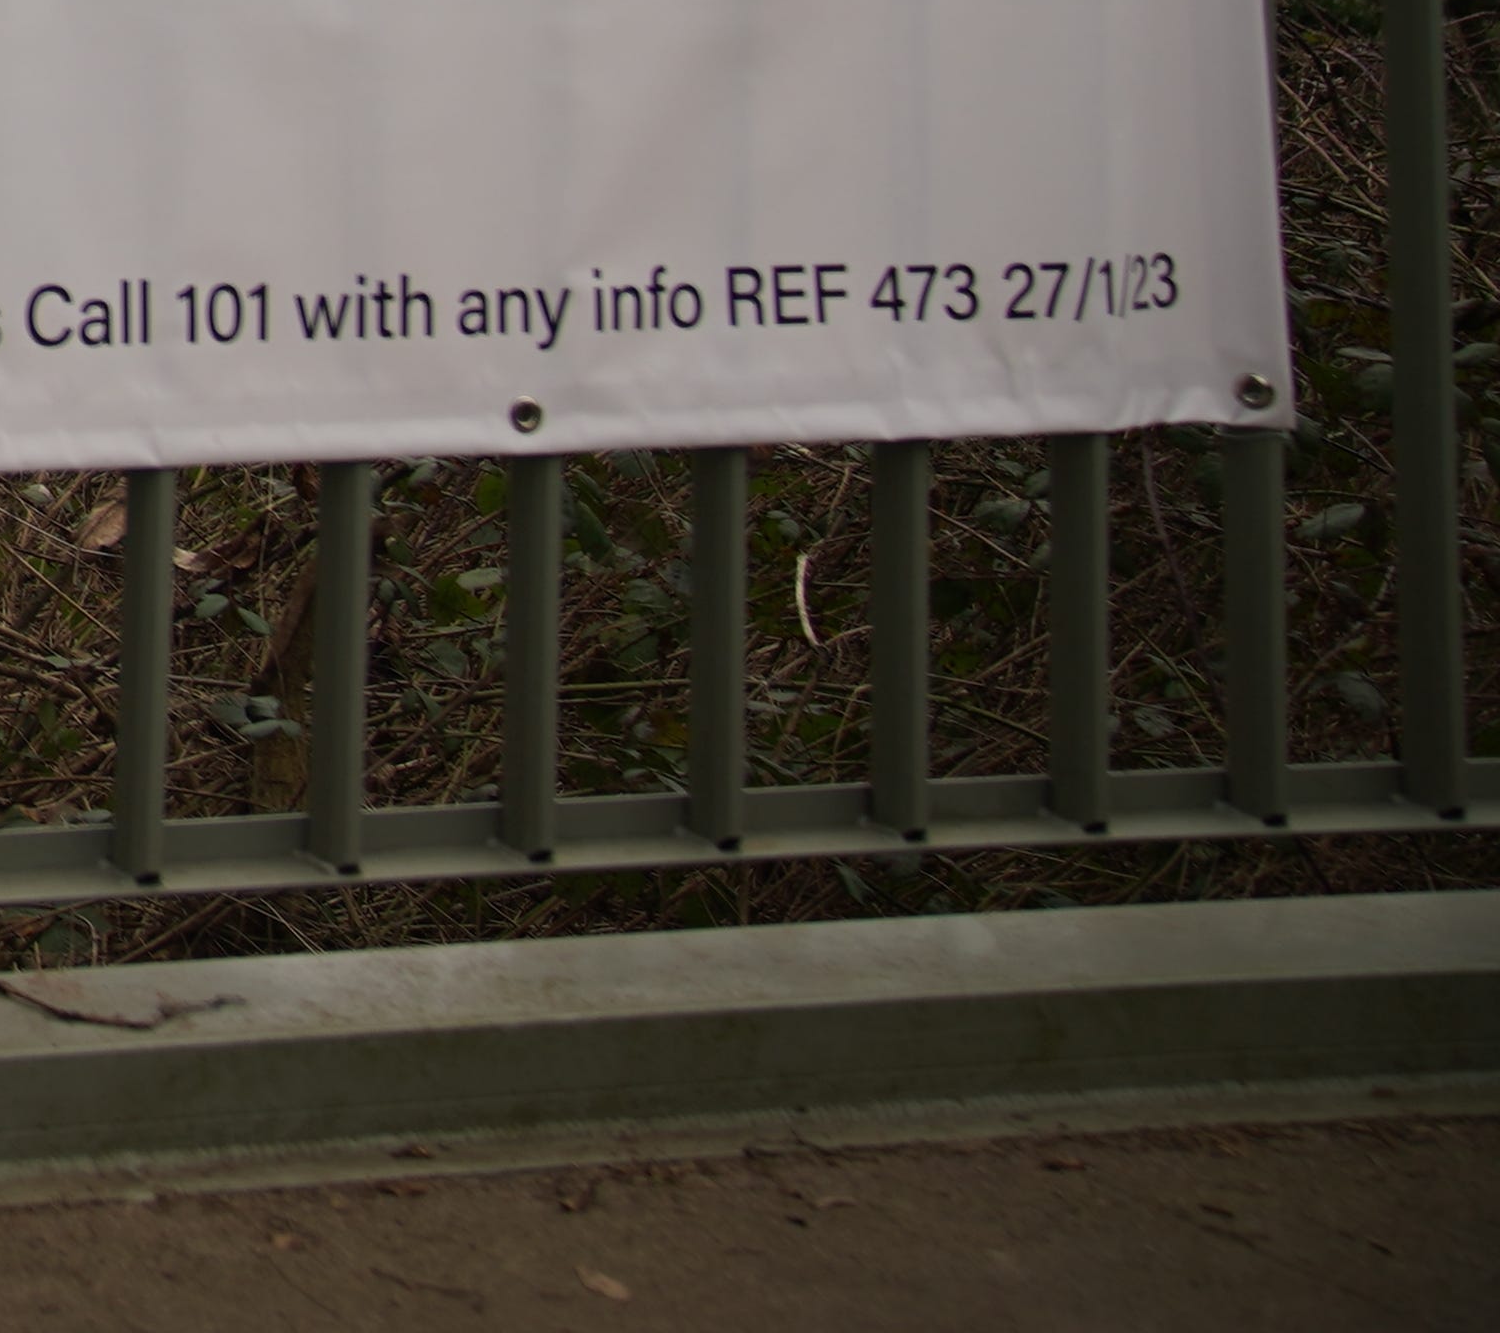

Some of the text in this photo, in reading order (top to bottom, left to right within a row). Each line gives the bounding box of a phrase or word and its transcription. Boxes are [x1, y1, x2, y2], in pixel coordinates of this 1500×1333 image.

[25, 278, 151, 348] Call
[176, 282, 269, 344] 101
[293, 273, 434, 341] with
[457, 287, 572, 352] any
[592, 264, 704, 333] info
[725, 263, 848, 327] REF
[869, 262, 981, 322] 473
[1002, 252, 1179, 322] 27/1/23
